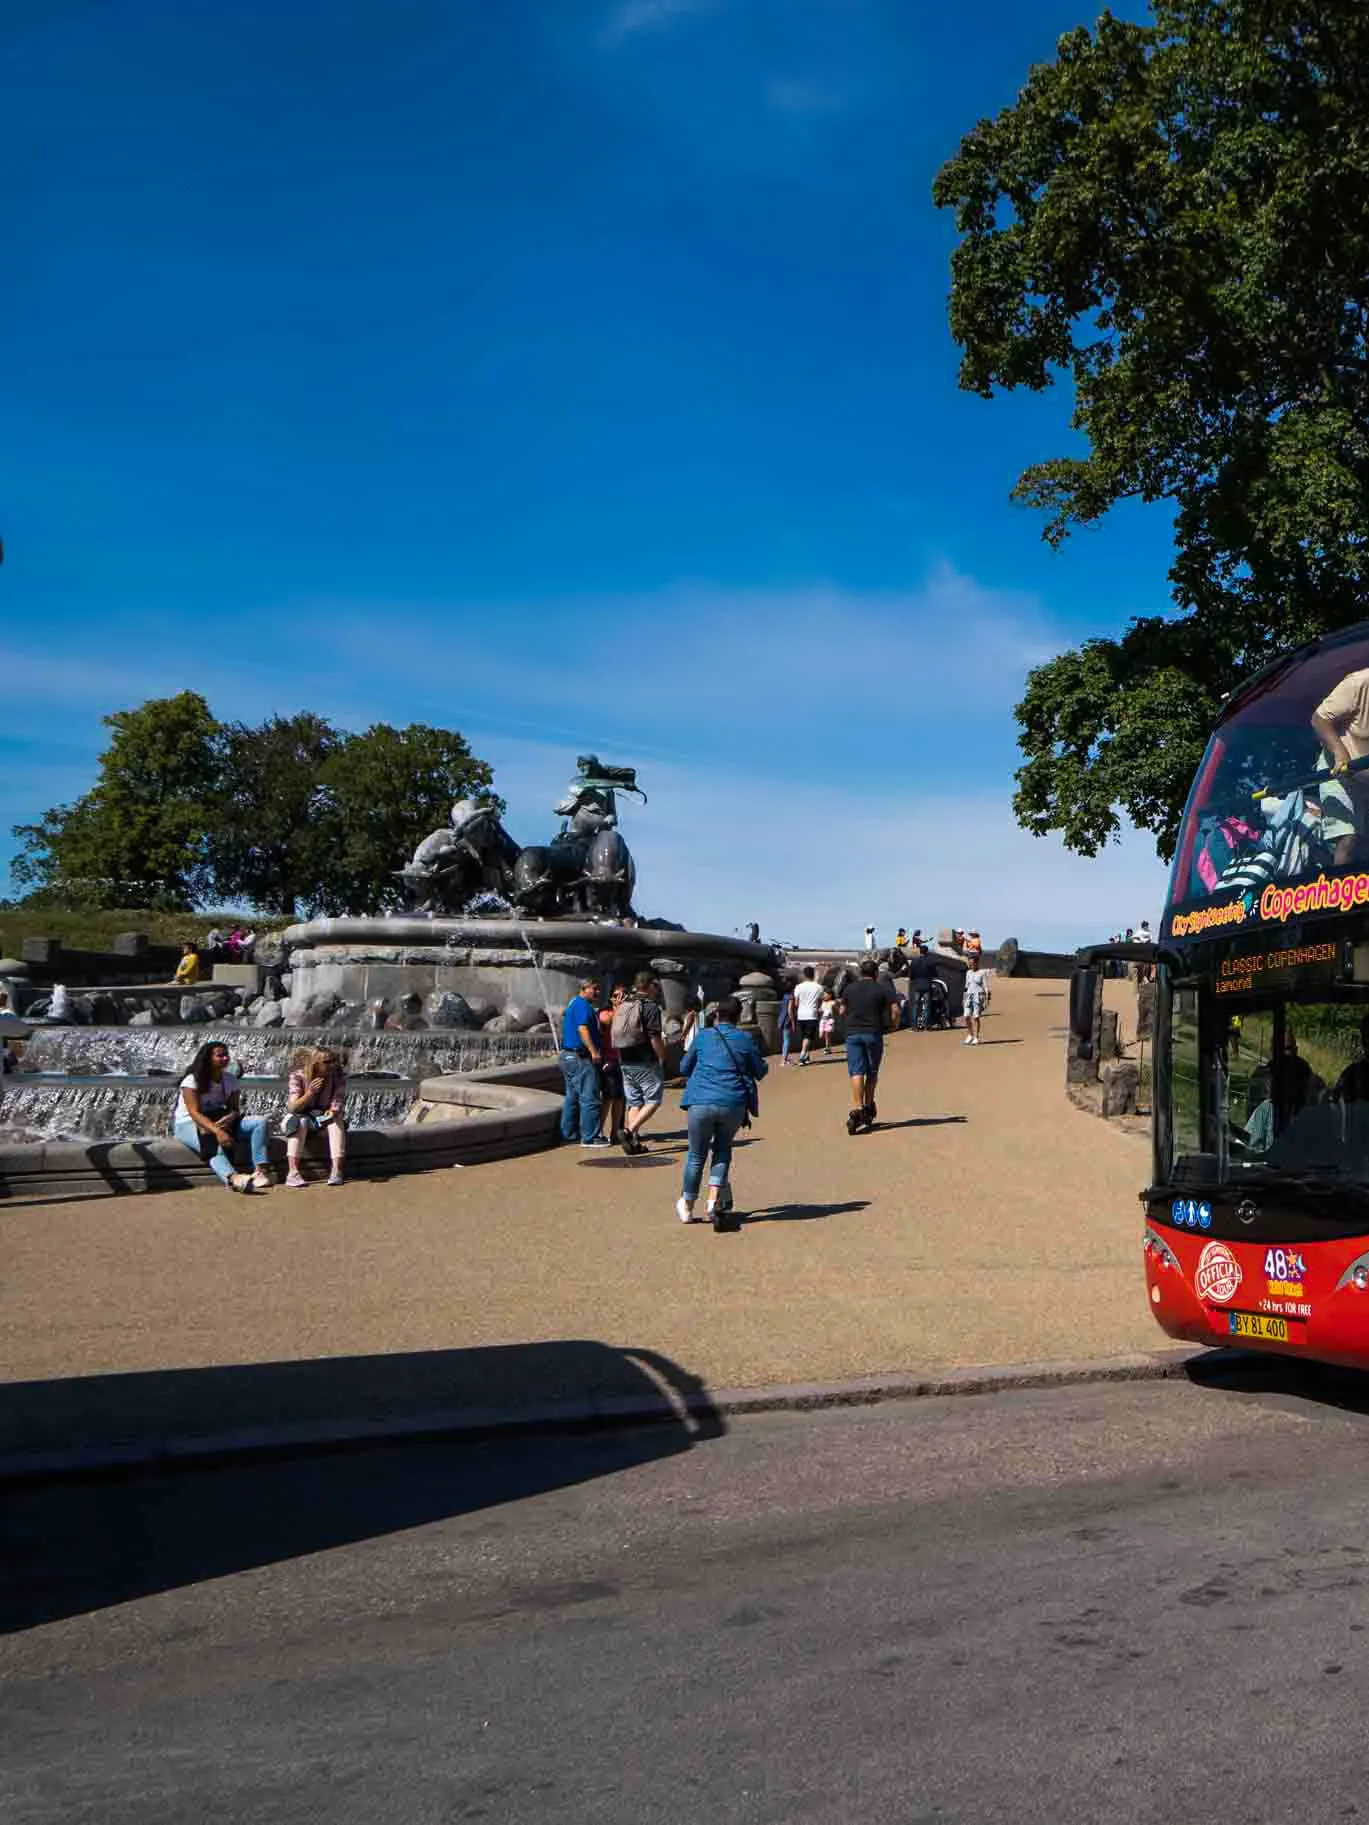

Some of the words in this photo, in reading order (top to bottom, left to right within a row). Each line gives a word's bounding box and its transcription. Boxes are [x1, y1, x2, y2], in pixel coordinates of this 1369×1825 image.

[1220, 955, 1264, 976] CLASSIC
[1267, 943, 1337, 969] COPENHAGEN
[1200, 1263, 1241, 1289] OFFICIAL
[1264, 1249, 1288, 1279] 48
[1285, 1302, 1297, 1314] FOR
[1298, 1304, 1312, 1317] FREE
[1251, 1317, 1263, 1336] 81
[1266, 1319, 1285, 1338] 400
